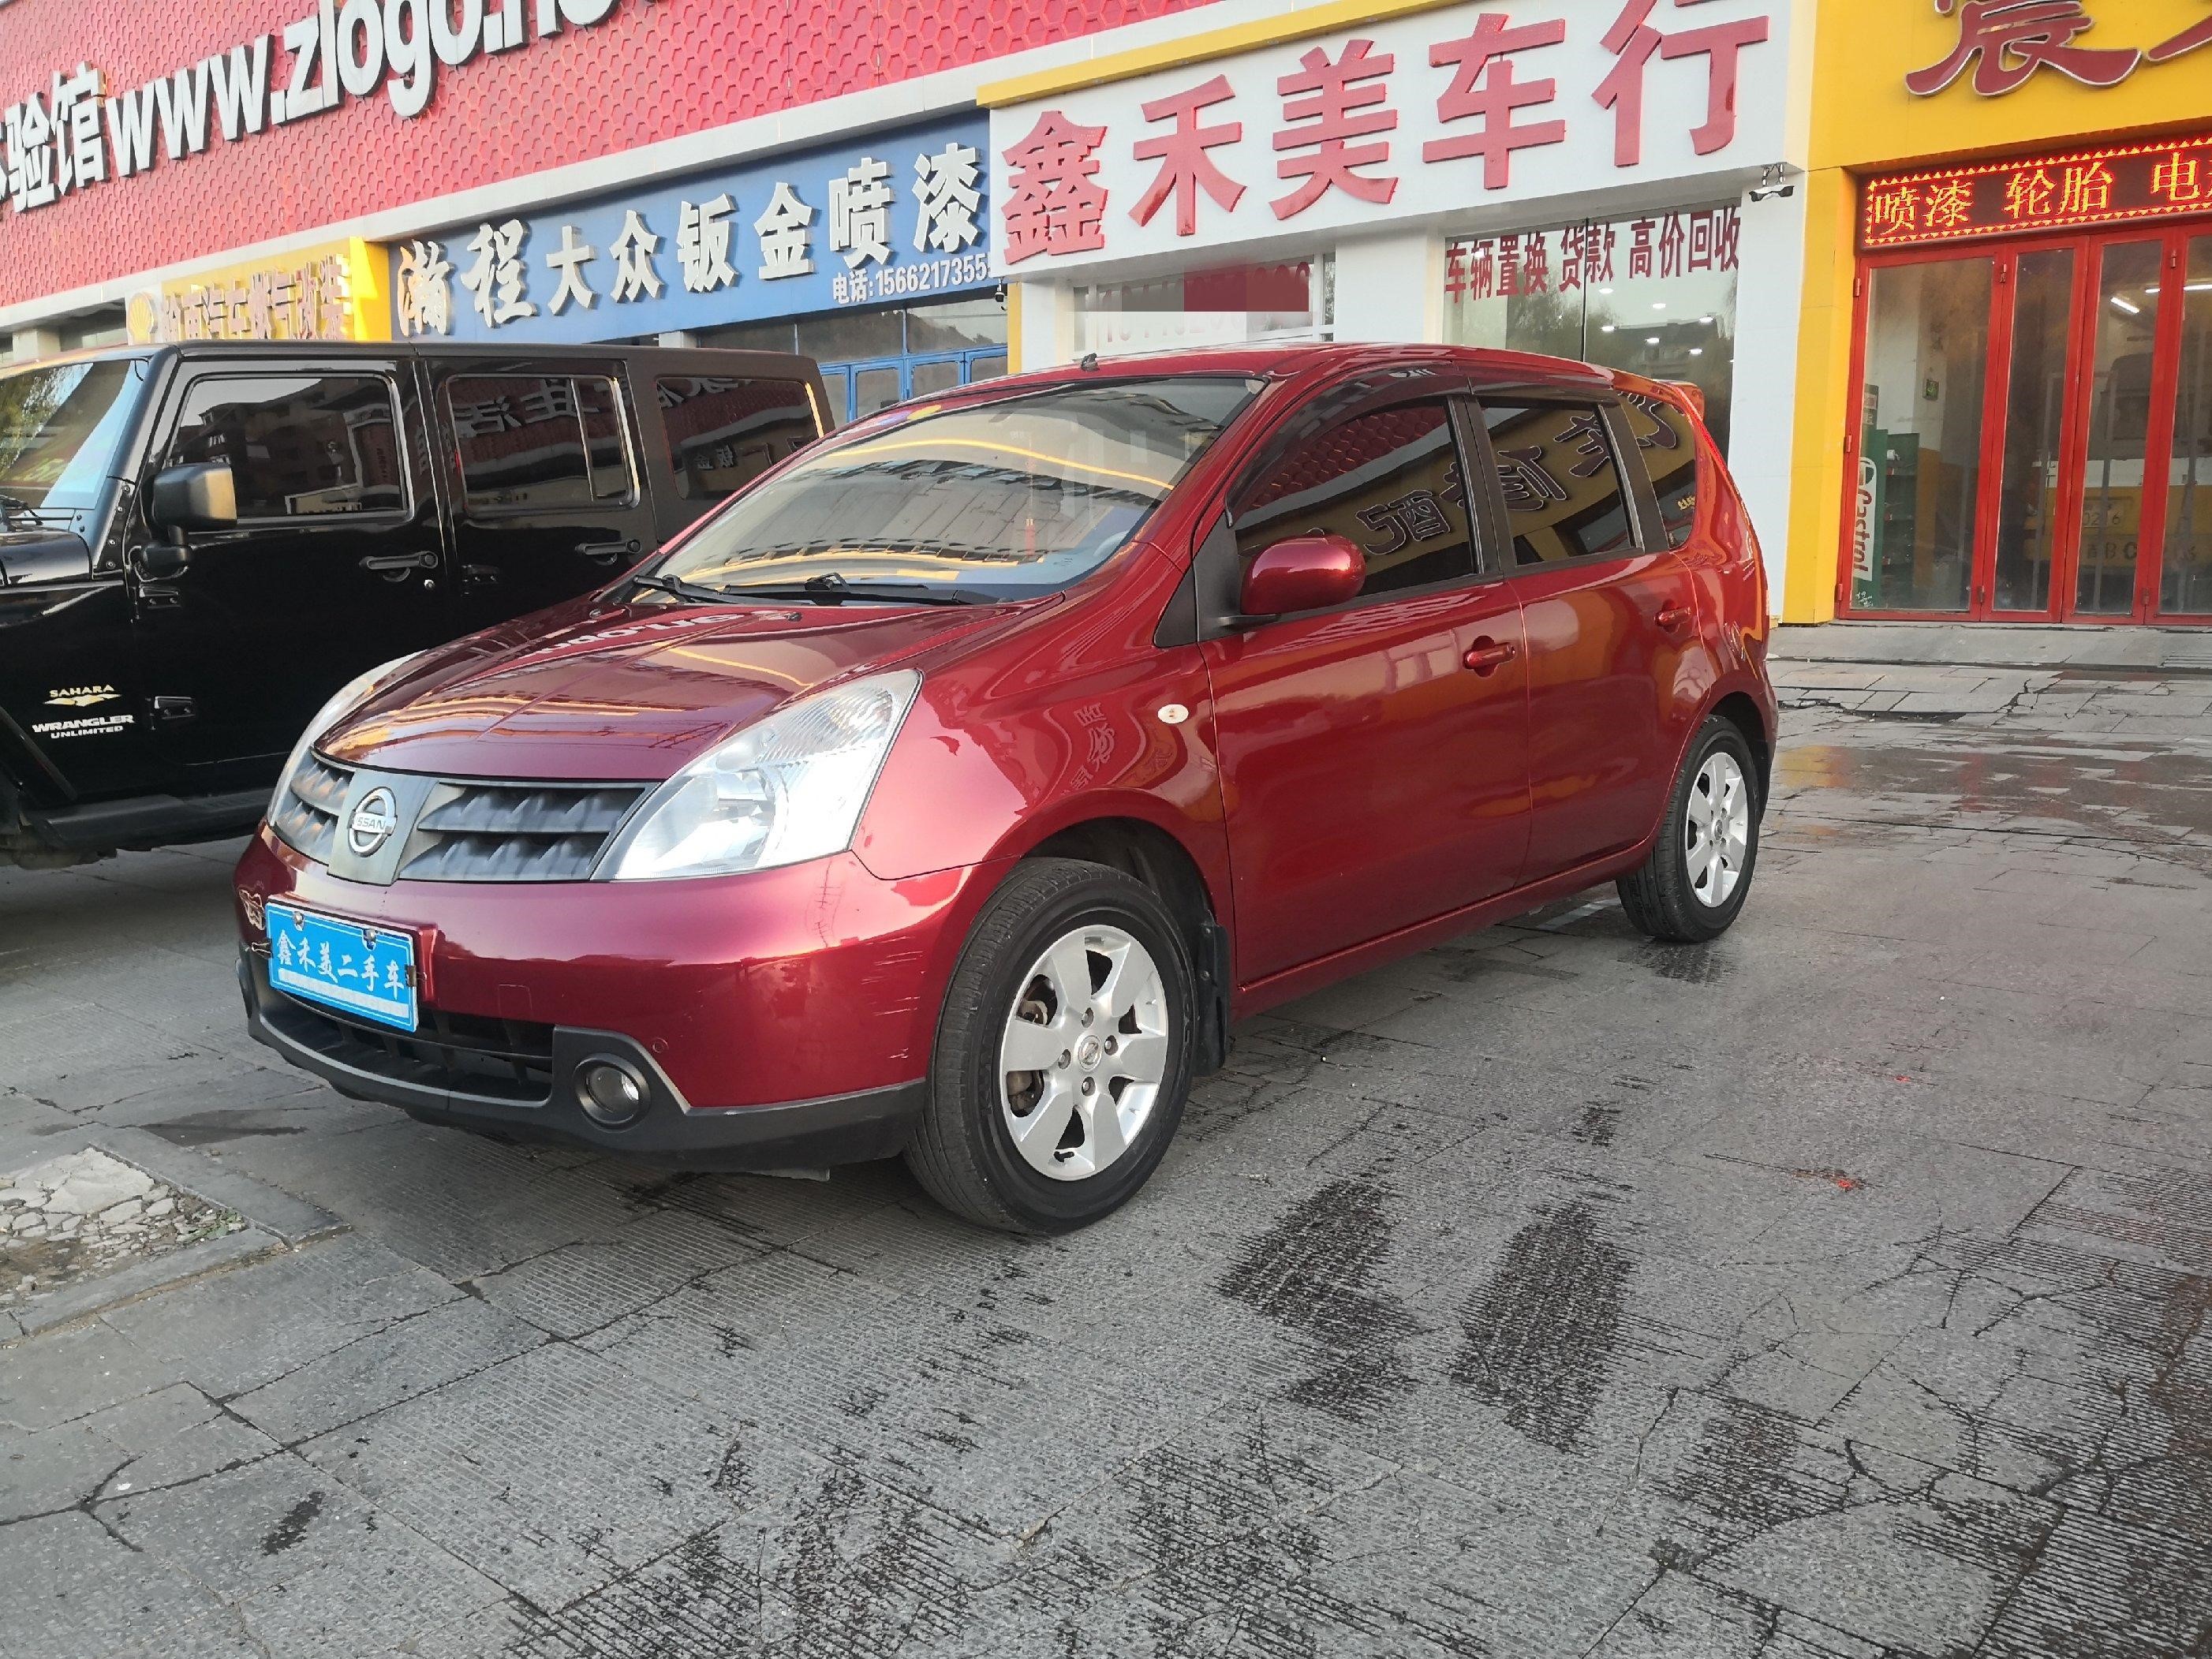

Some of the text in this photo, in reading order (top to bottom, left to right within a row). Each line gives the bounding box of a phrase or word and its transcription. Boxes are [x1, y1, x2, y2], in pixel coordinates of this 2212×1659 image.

[0, 60, 106, 213] 验馆
[1000, 0, 1769, 266] 鑫禾美车行
[1873, 179, 1974, 236] 喷漆
[2003, 161, 2114, 219] 轮胎
[832, 252, 992, 305] 电话:1566217355
[1444, 230, 1549, 304] 车辆置换
[1628, 205, 1741, 279] 高价回收
[49, 684, 115, 698] SAHARA
[32, 714, 136, 733] WRANGLER
[50, 725, 125, 739] UNLIMITED
